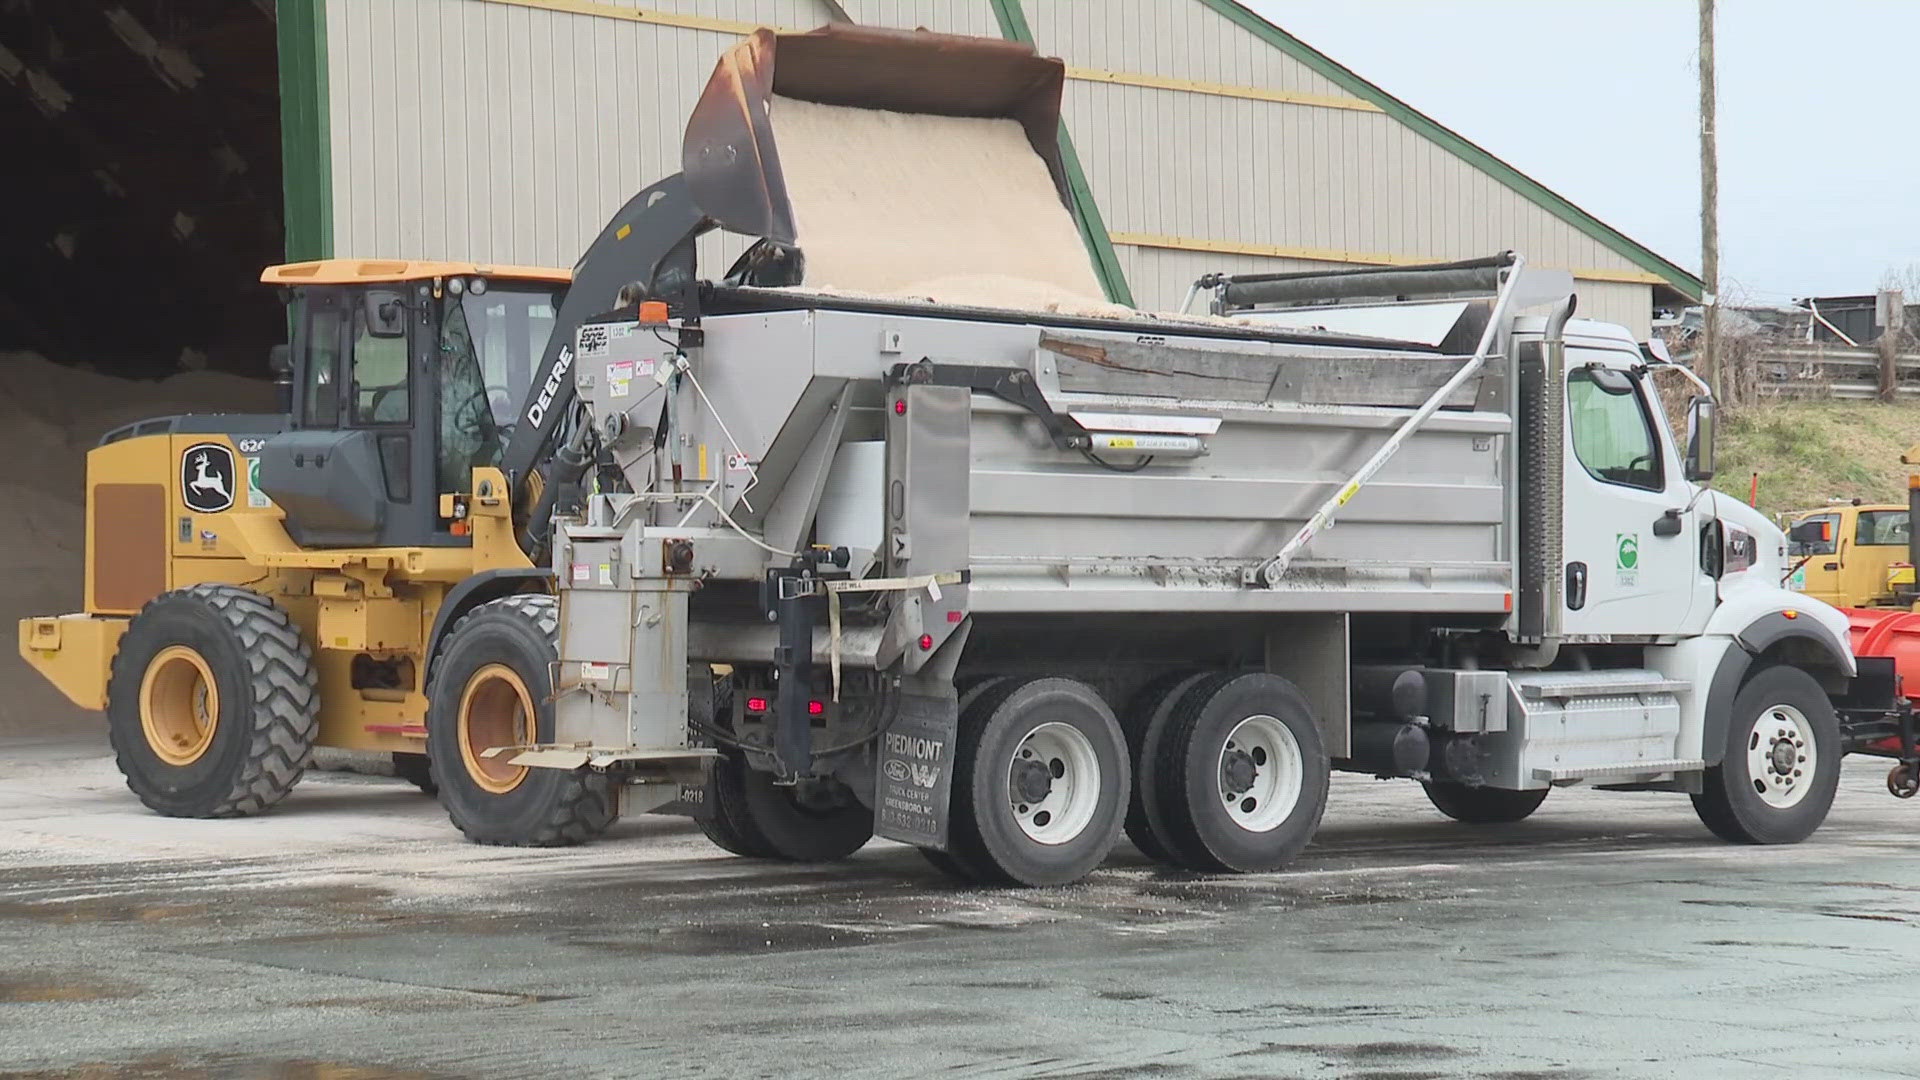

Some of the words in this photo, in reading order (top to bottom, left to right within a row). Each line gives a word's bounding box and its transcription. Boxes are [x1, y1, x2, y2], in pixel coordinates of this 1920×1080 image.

[527, 344, 574, 428] DEERE
[885, 731, 943, 761] PIEDMONT
[886, 760, 908, 780] Ford
[906, 788, 930, 801] CENTER
[923, 805, 933, 816] NC
